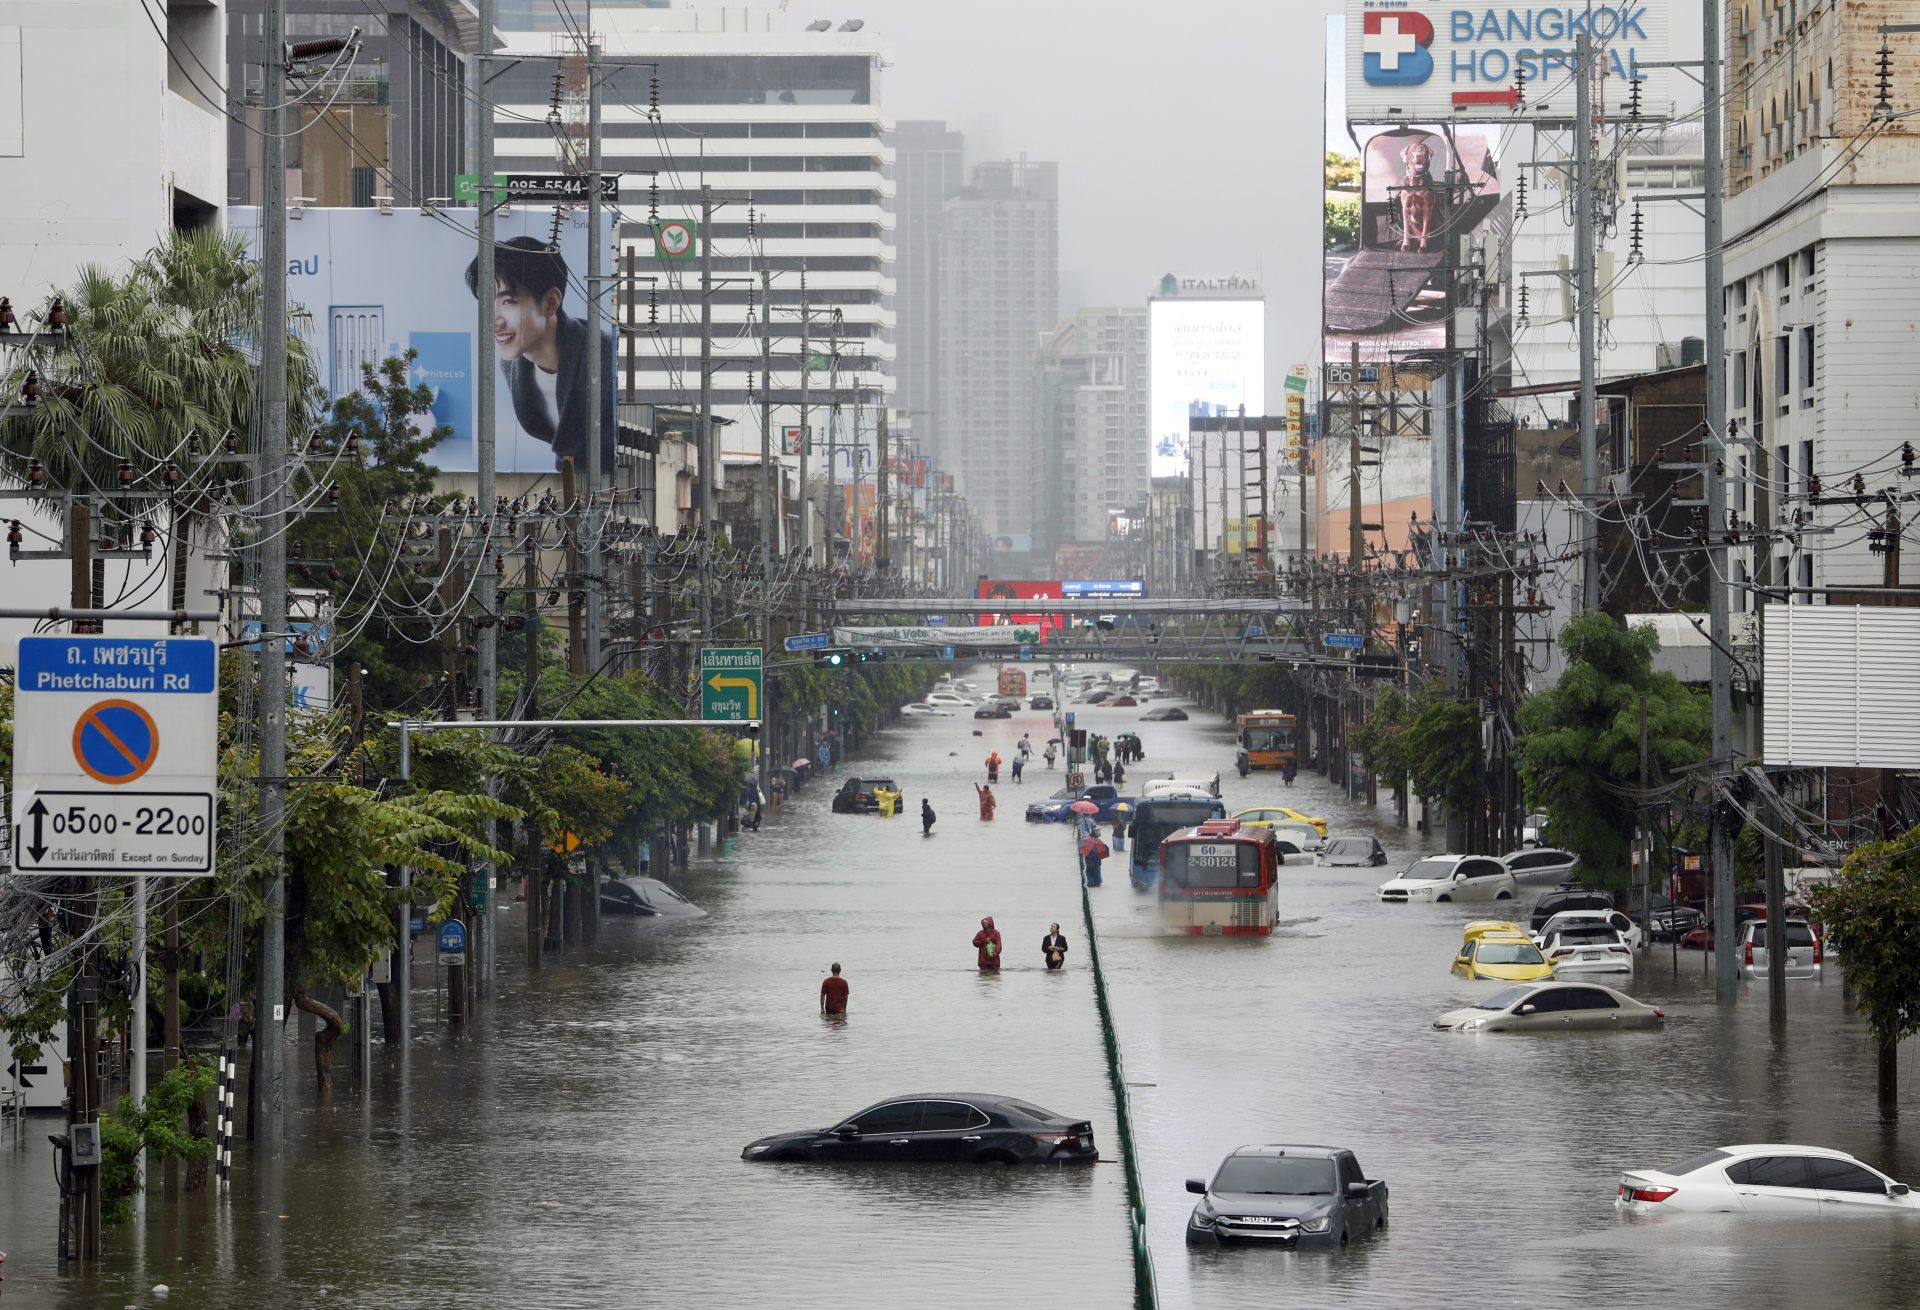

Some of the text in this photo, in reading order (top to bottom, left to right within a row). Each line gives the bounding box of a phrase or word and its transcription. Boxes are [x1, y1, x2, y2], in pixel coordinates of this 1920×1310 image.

[1451, 7, 1648, 41] BANGKOK
[1182, 279, 1256, 290] ITALTHAI
[424, 369, 465, 379] hiteLab
[851, 629, 928, 643] Bangkok Vote
[67, 640, 168, 672] ถ. เพชรบุรี
[703, 651, 760, 666] เส้นทางลัด
[37, 672, 191, 690] Phetchaburi Rd
[711, 700, 741, 713] สุขุมวิท
[730, 712, 741, 720] 55
[51, 848, 205, 865] เว้นวันอาทิตย์ Except on Sunday
[1201, 845, 1216, 856] 60
[1188, 856, 1237, 867] 2-80126
[275, 1008, 282, 1017] 6
